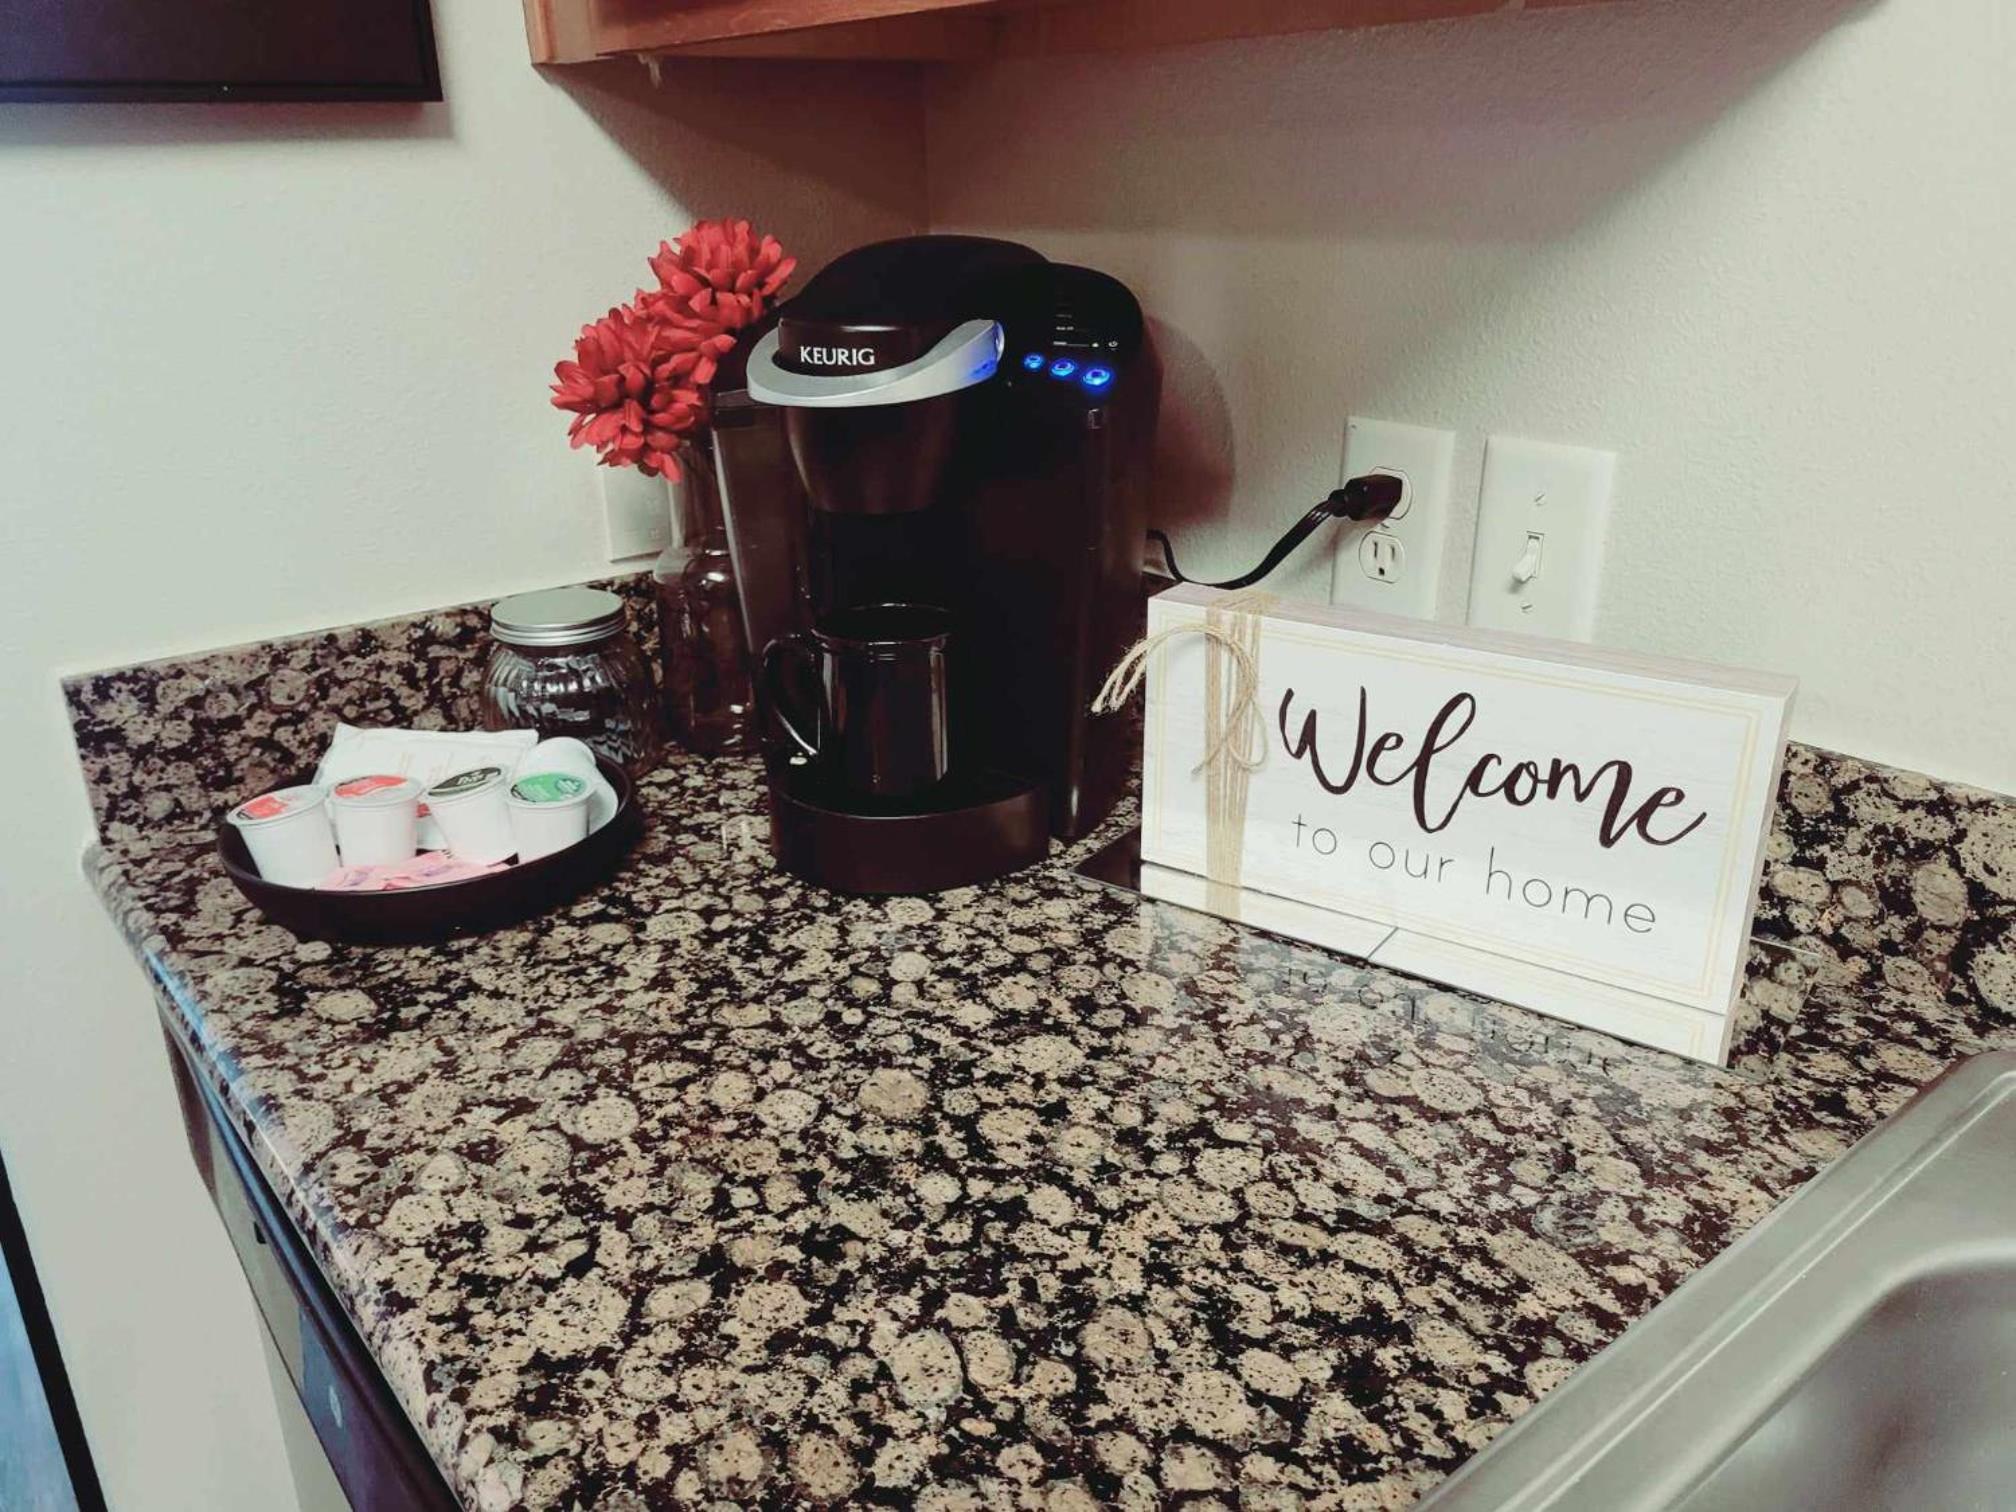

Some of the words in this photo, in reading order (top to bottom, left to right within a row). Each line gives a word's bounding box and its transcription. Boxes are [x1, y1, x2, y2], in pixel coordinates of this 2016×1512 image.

[800, 345, 875, 366] KEURIG
[1278, 686, 1707, 849] Welcome
[1292, 813, 1338, 855] to
[1369, 841, 1454, 883] our
[1486, 846, 1656, 934] home
